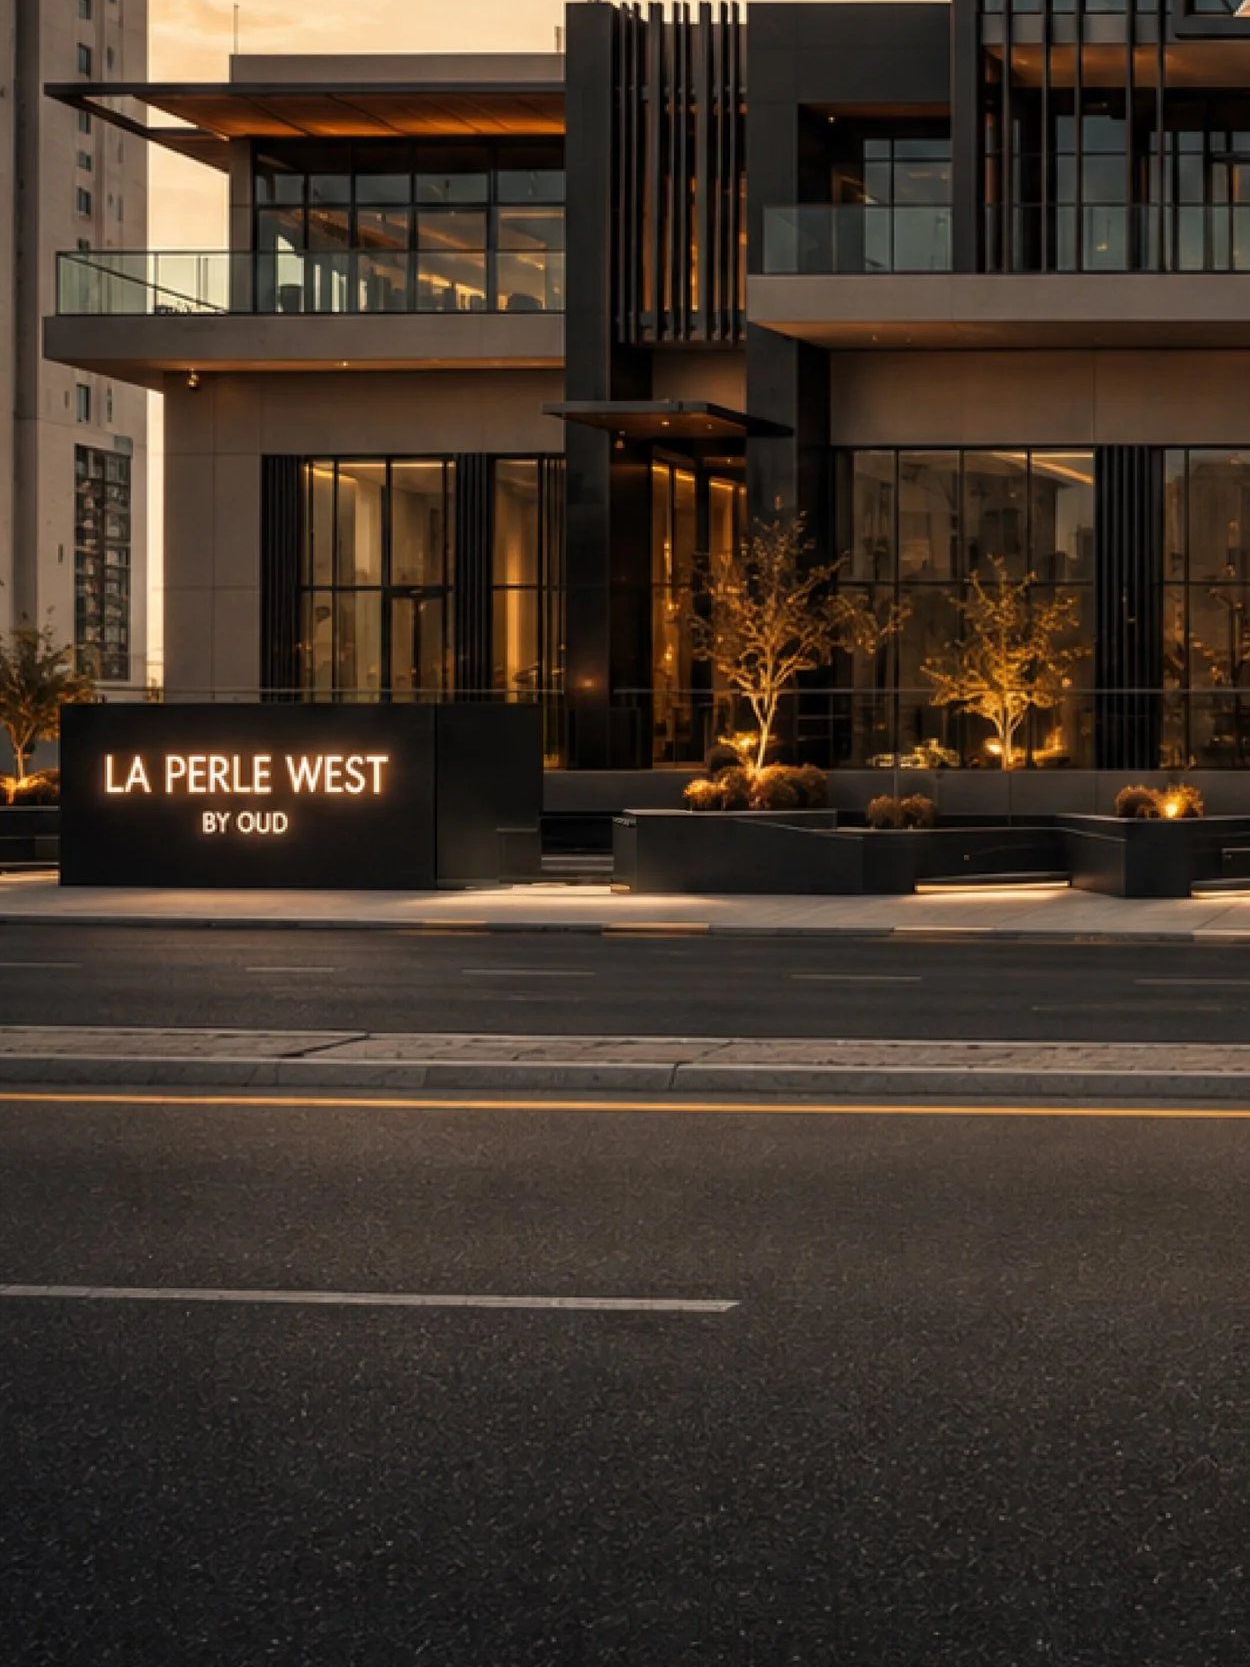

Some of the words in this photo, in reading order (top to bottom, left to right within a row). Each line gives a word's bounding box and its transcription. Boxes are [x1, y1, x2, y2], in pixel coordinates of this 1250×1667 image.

[104, 753, 151, 794] LA
[165, 753, 272, 794] PERLE
[284, 753, 389, 794] WEST
[202, 811, 231, 834] BY
[237, 811, 289, 834] OUD
